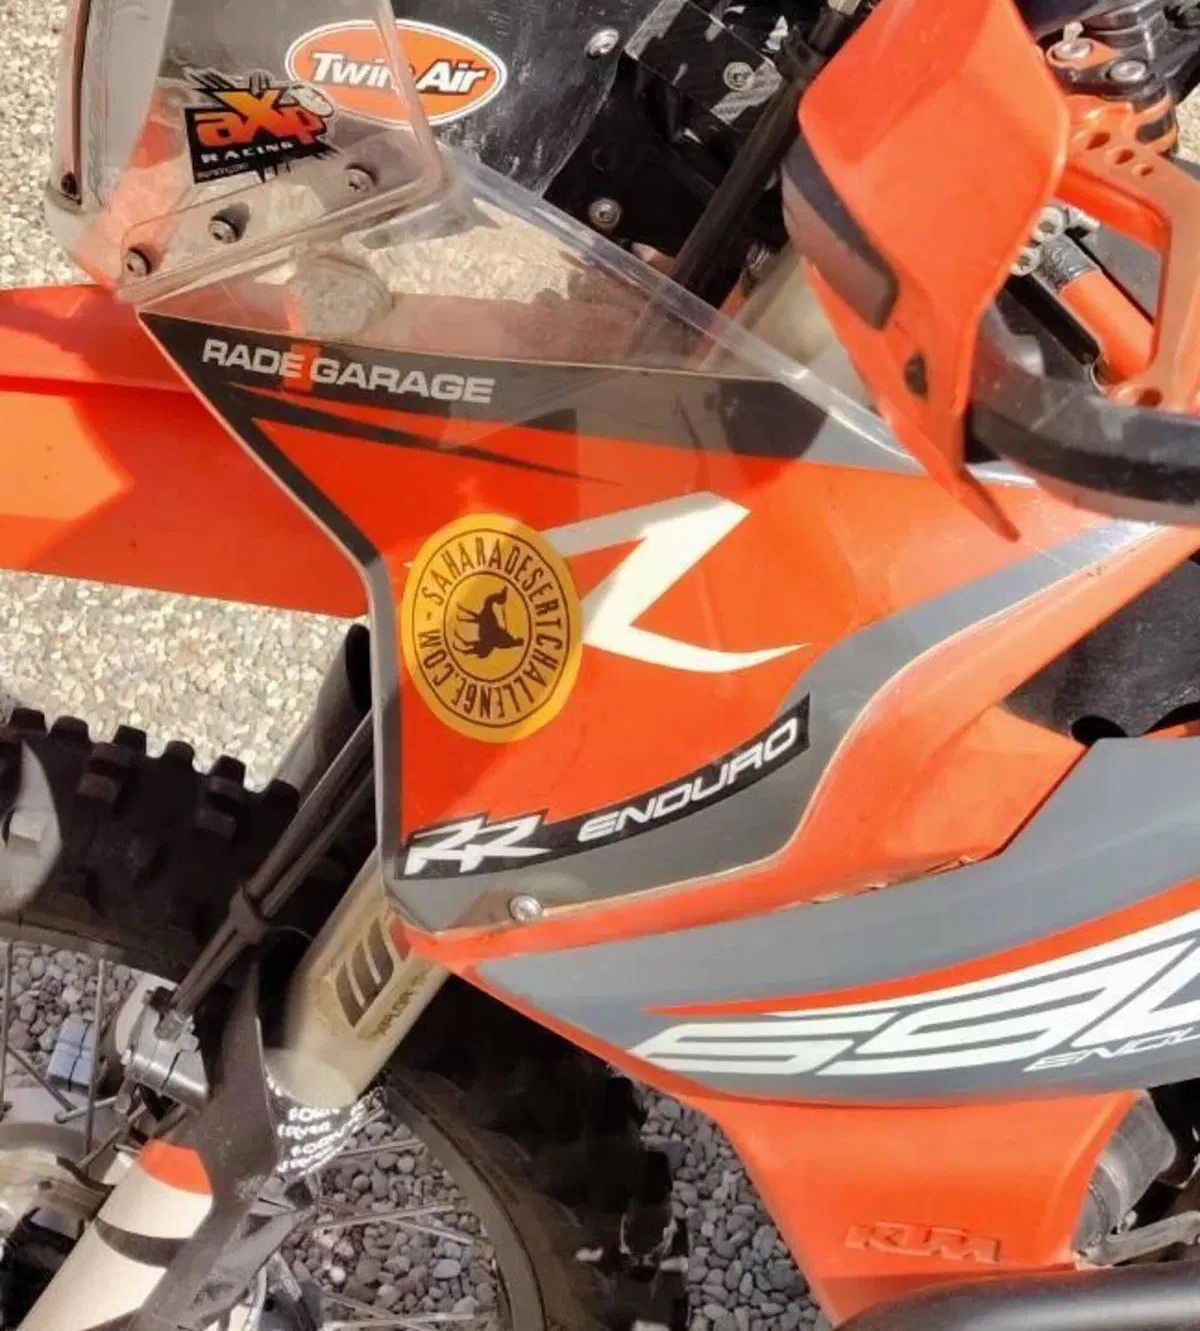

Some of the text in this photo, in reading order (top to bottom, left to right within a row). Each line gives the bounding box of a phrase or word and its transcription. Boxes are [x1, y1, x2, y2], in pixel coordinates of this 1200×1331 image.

[415, 61, 487, 93] Air
[200, 140, 294, 164] RACING
[202, 338, 496, 404] RADE GARAGE
[418, 536, 564, 719] SAHARADESERTCHALLENGE.COM
[577, 716, 799, 842] ENDURO
[844, 1221, 1002, 1265] KTM
